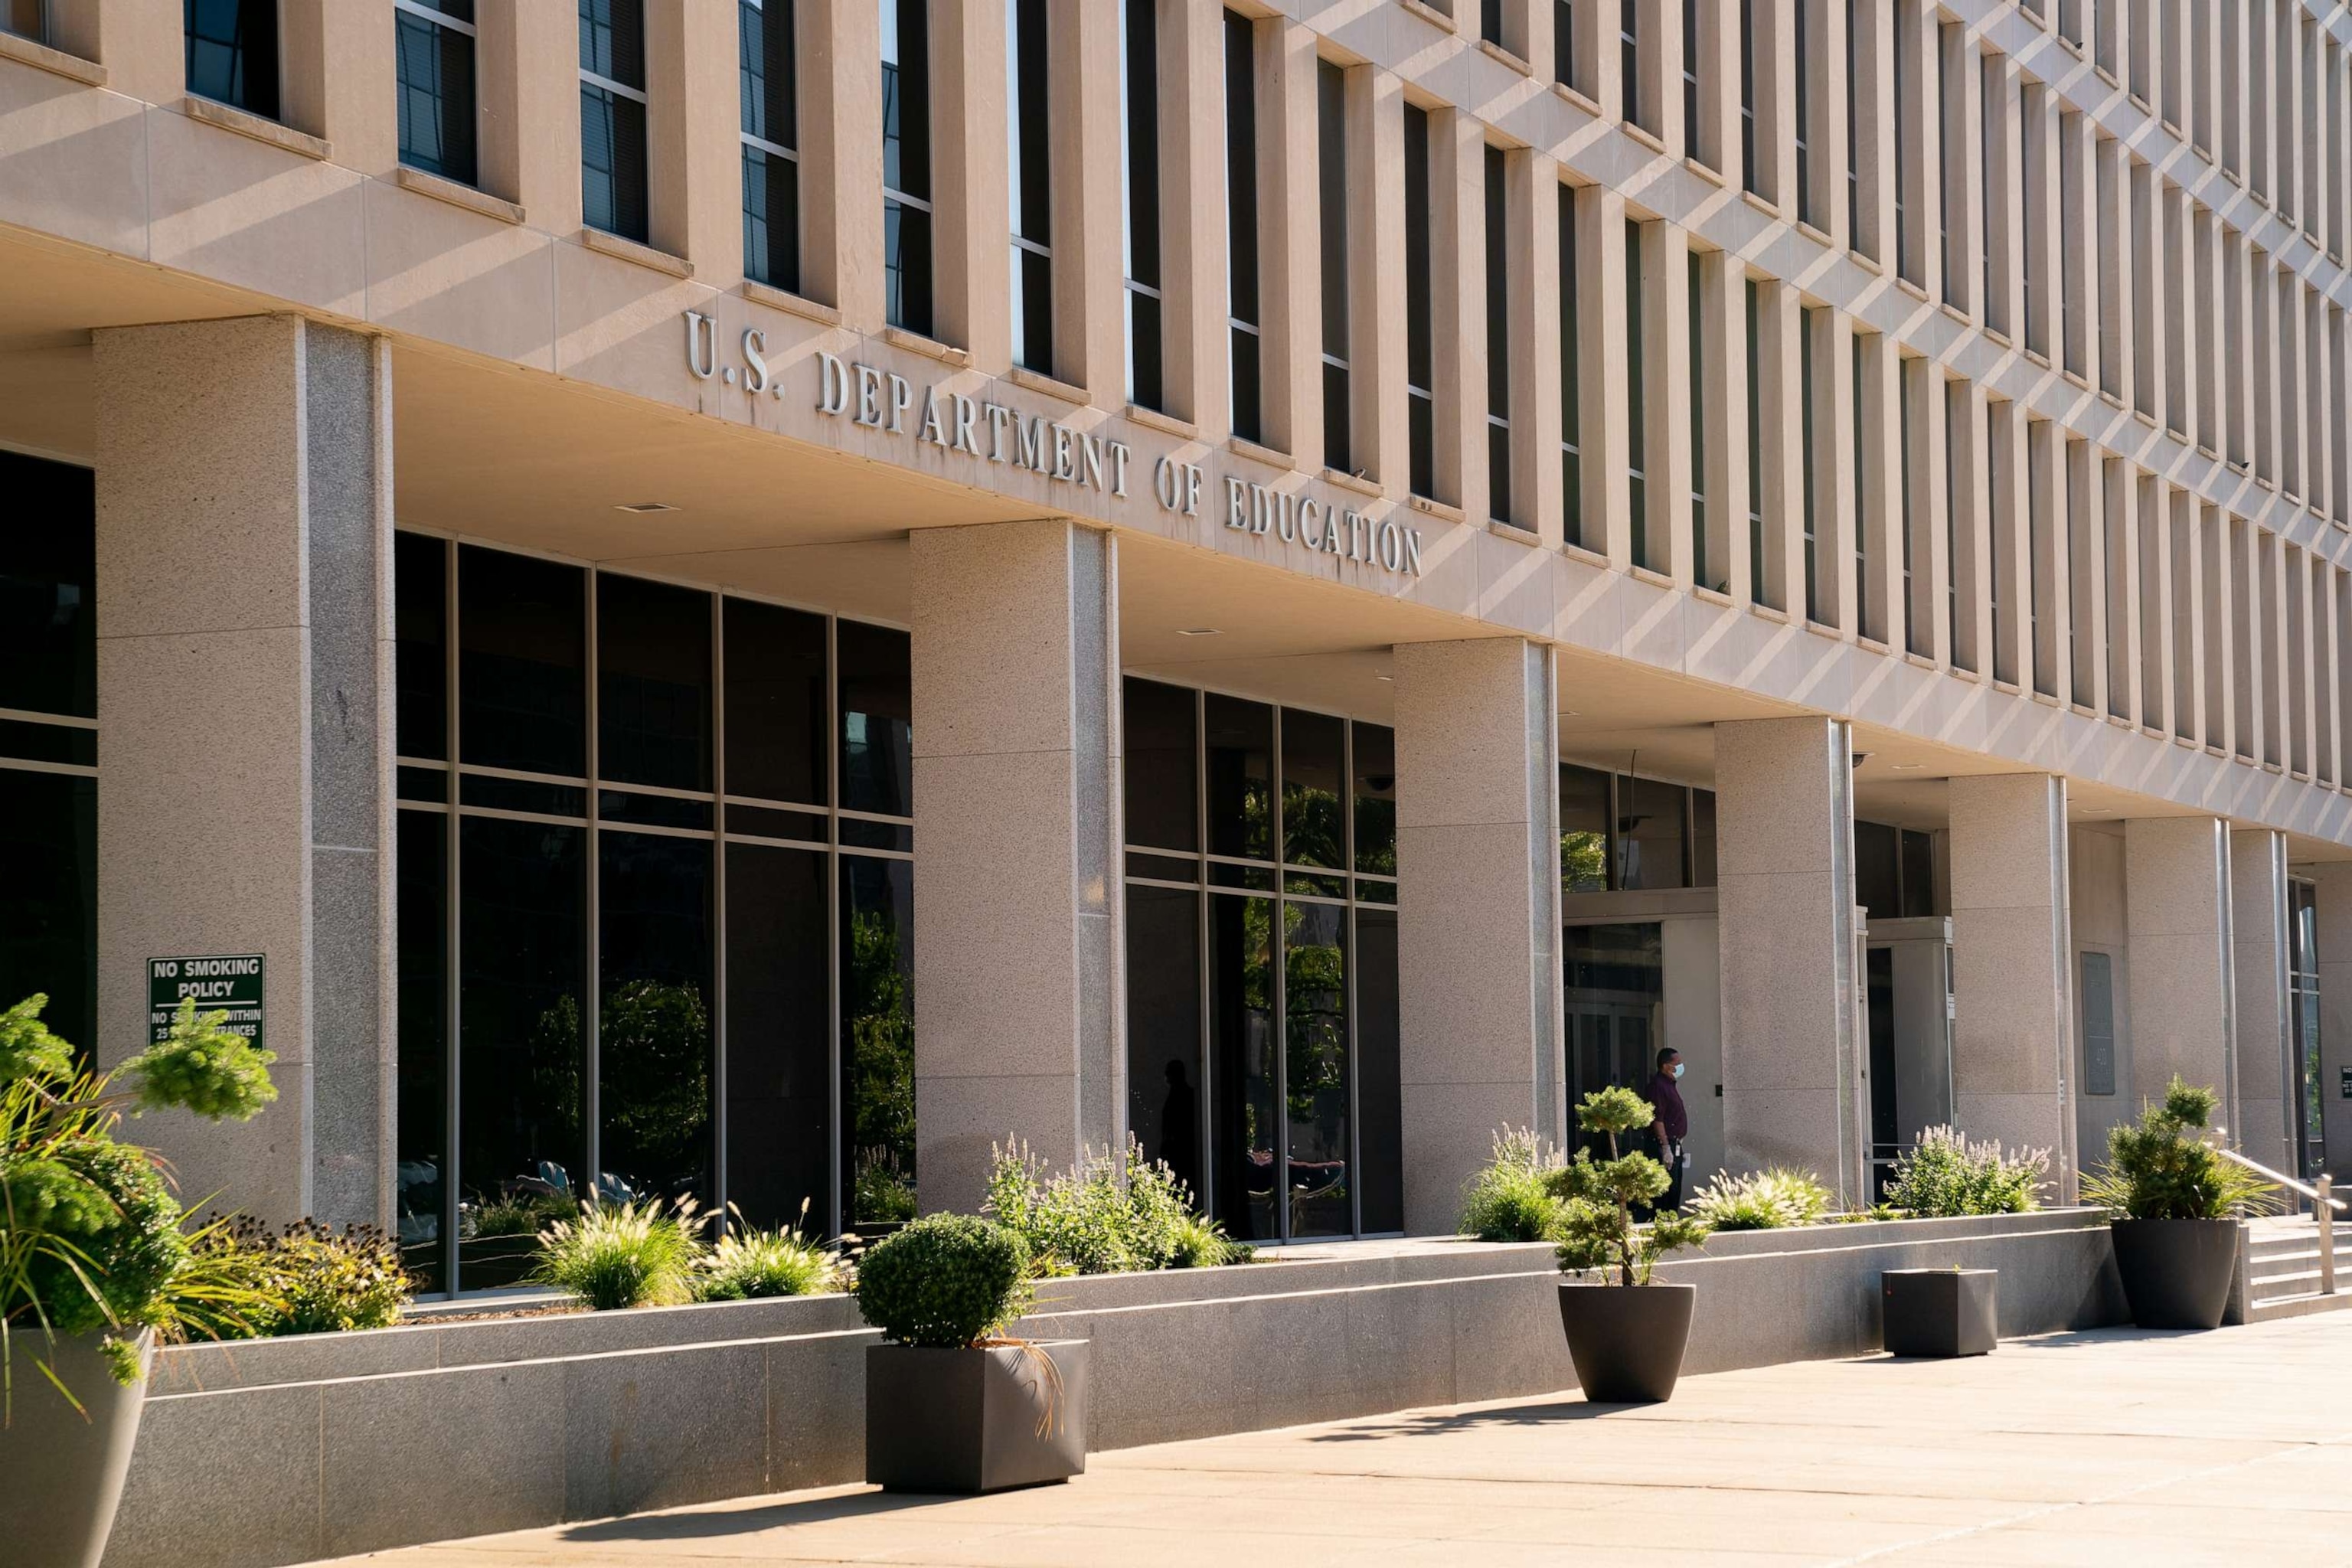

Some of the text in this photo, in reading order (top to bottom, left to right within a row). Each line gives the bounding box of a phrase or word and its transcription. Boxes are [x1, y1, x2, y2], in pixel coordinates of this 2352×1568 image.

[683, 310, 1421, 577] U.S. DEPARTMENT OF EDUCATION
[155, 959, 259, 978] NO SMOKING
[178, 981, 234, 998] POLICY
[152, 1012, 167, 1024] NO
[156, 1027, 168, 1040] 25
